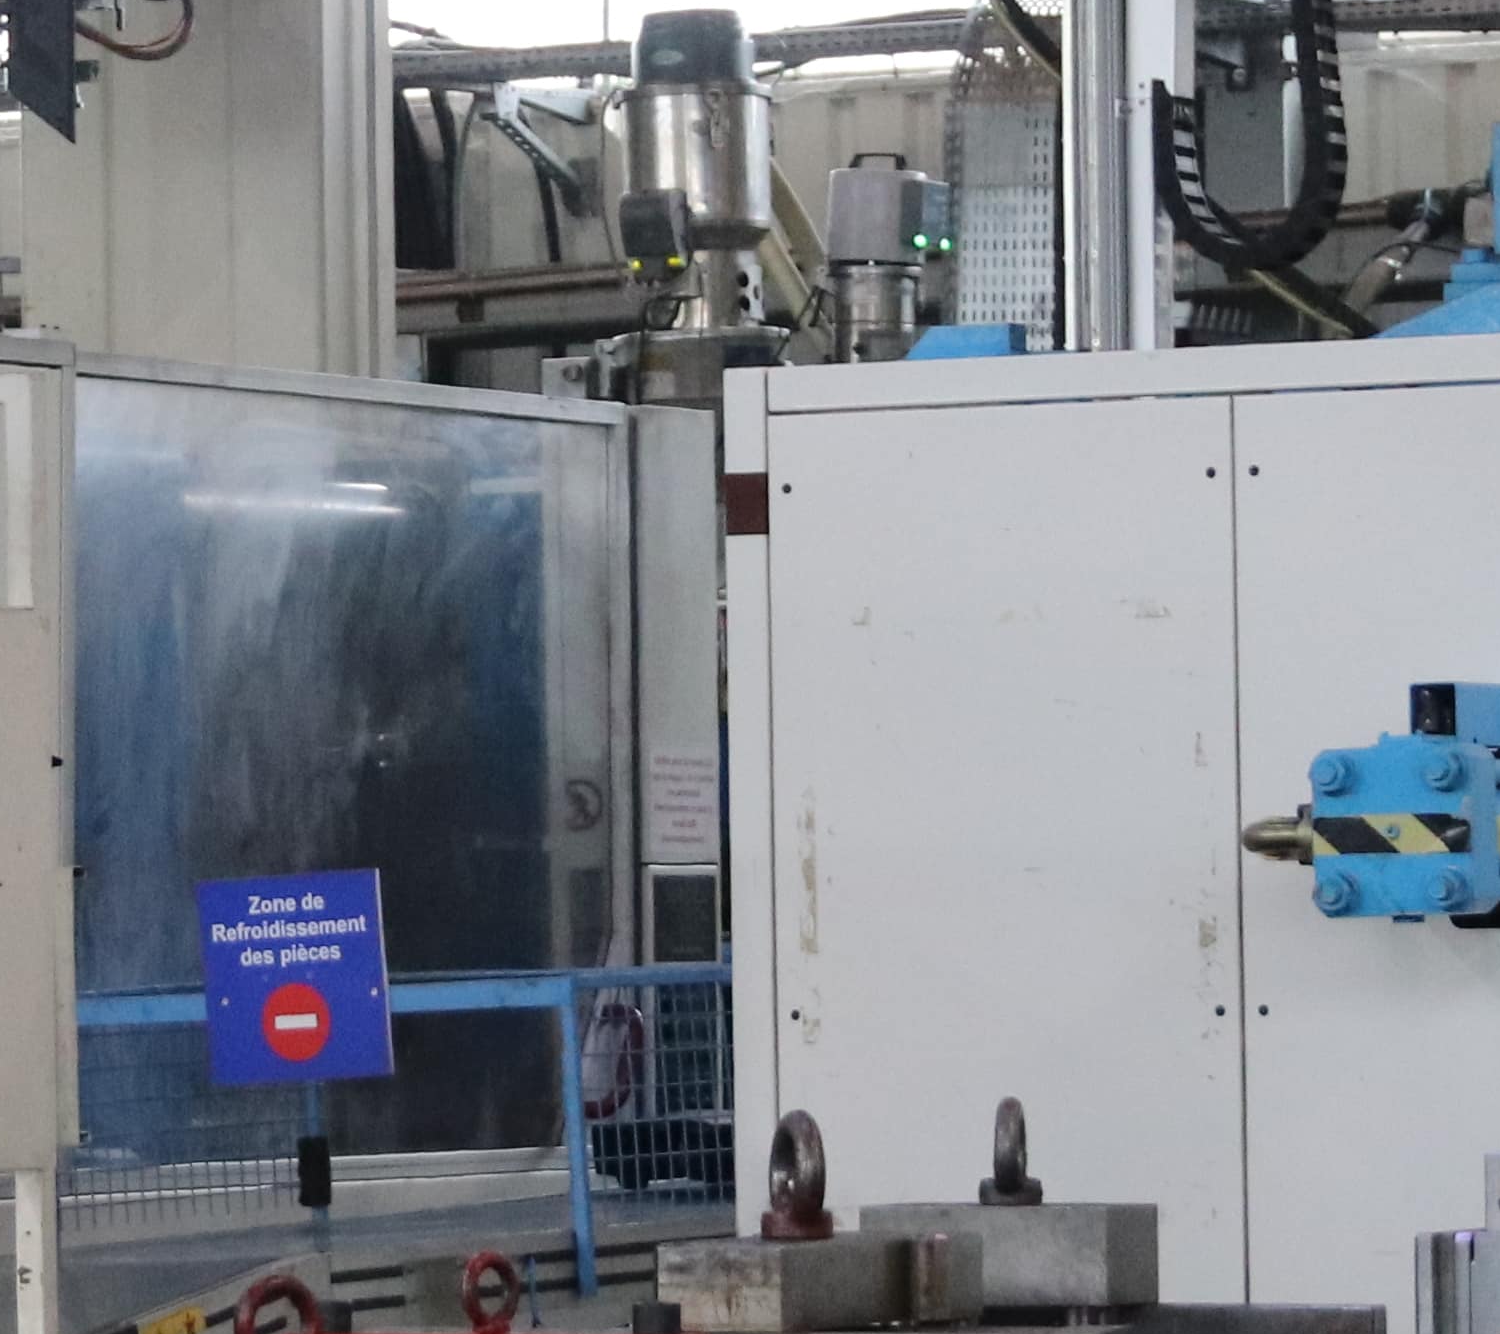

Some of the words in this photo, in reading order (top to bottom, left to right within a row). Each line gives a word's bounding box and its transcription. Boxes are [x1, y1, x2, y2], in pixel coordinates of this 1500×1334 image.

[248, 895, 296, 915] Zone
[301, 892, 325, 910] de
[211, 915, 367, 943] Refroidissement
[240, 947, 275, 967] des
[280, 943, 342, 967] pièces
